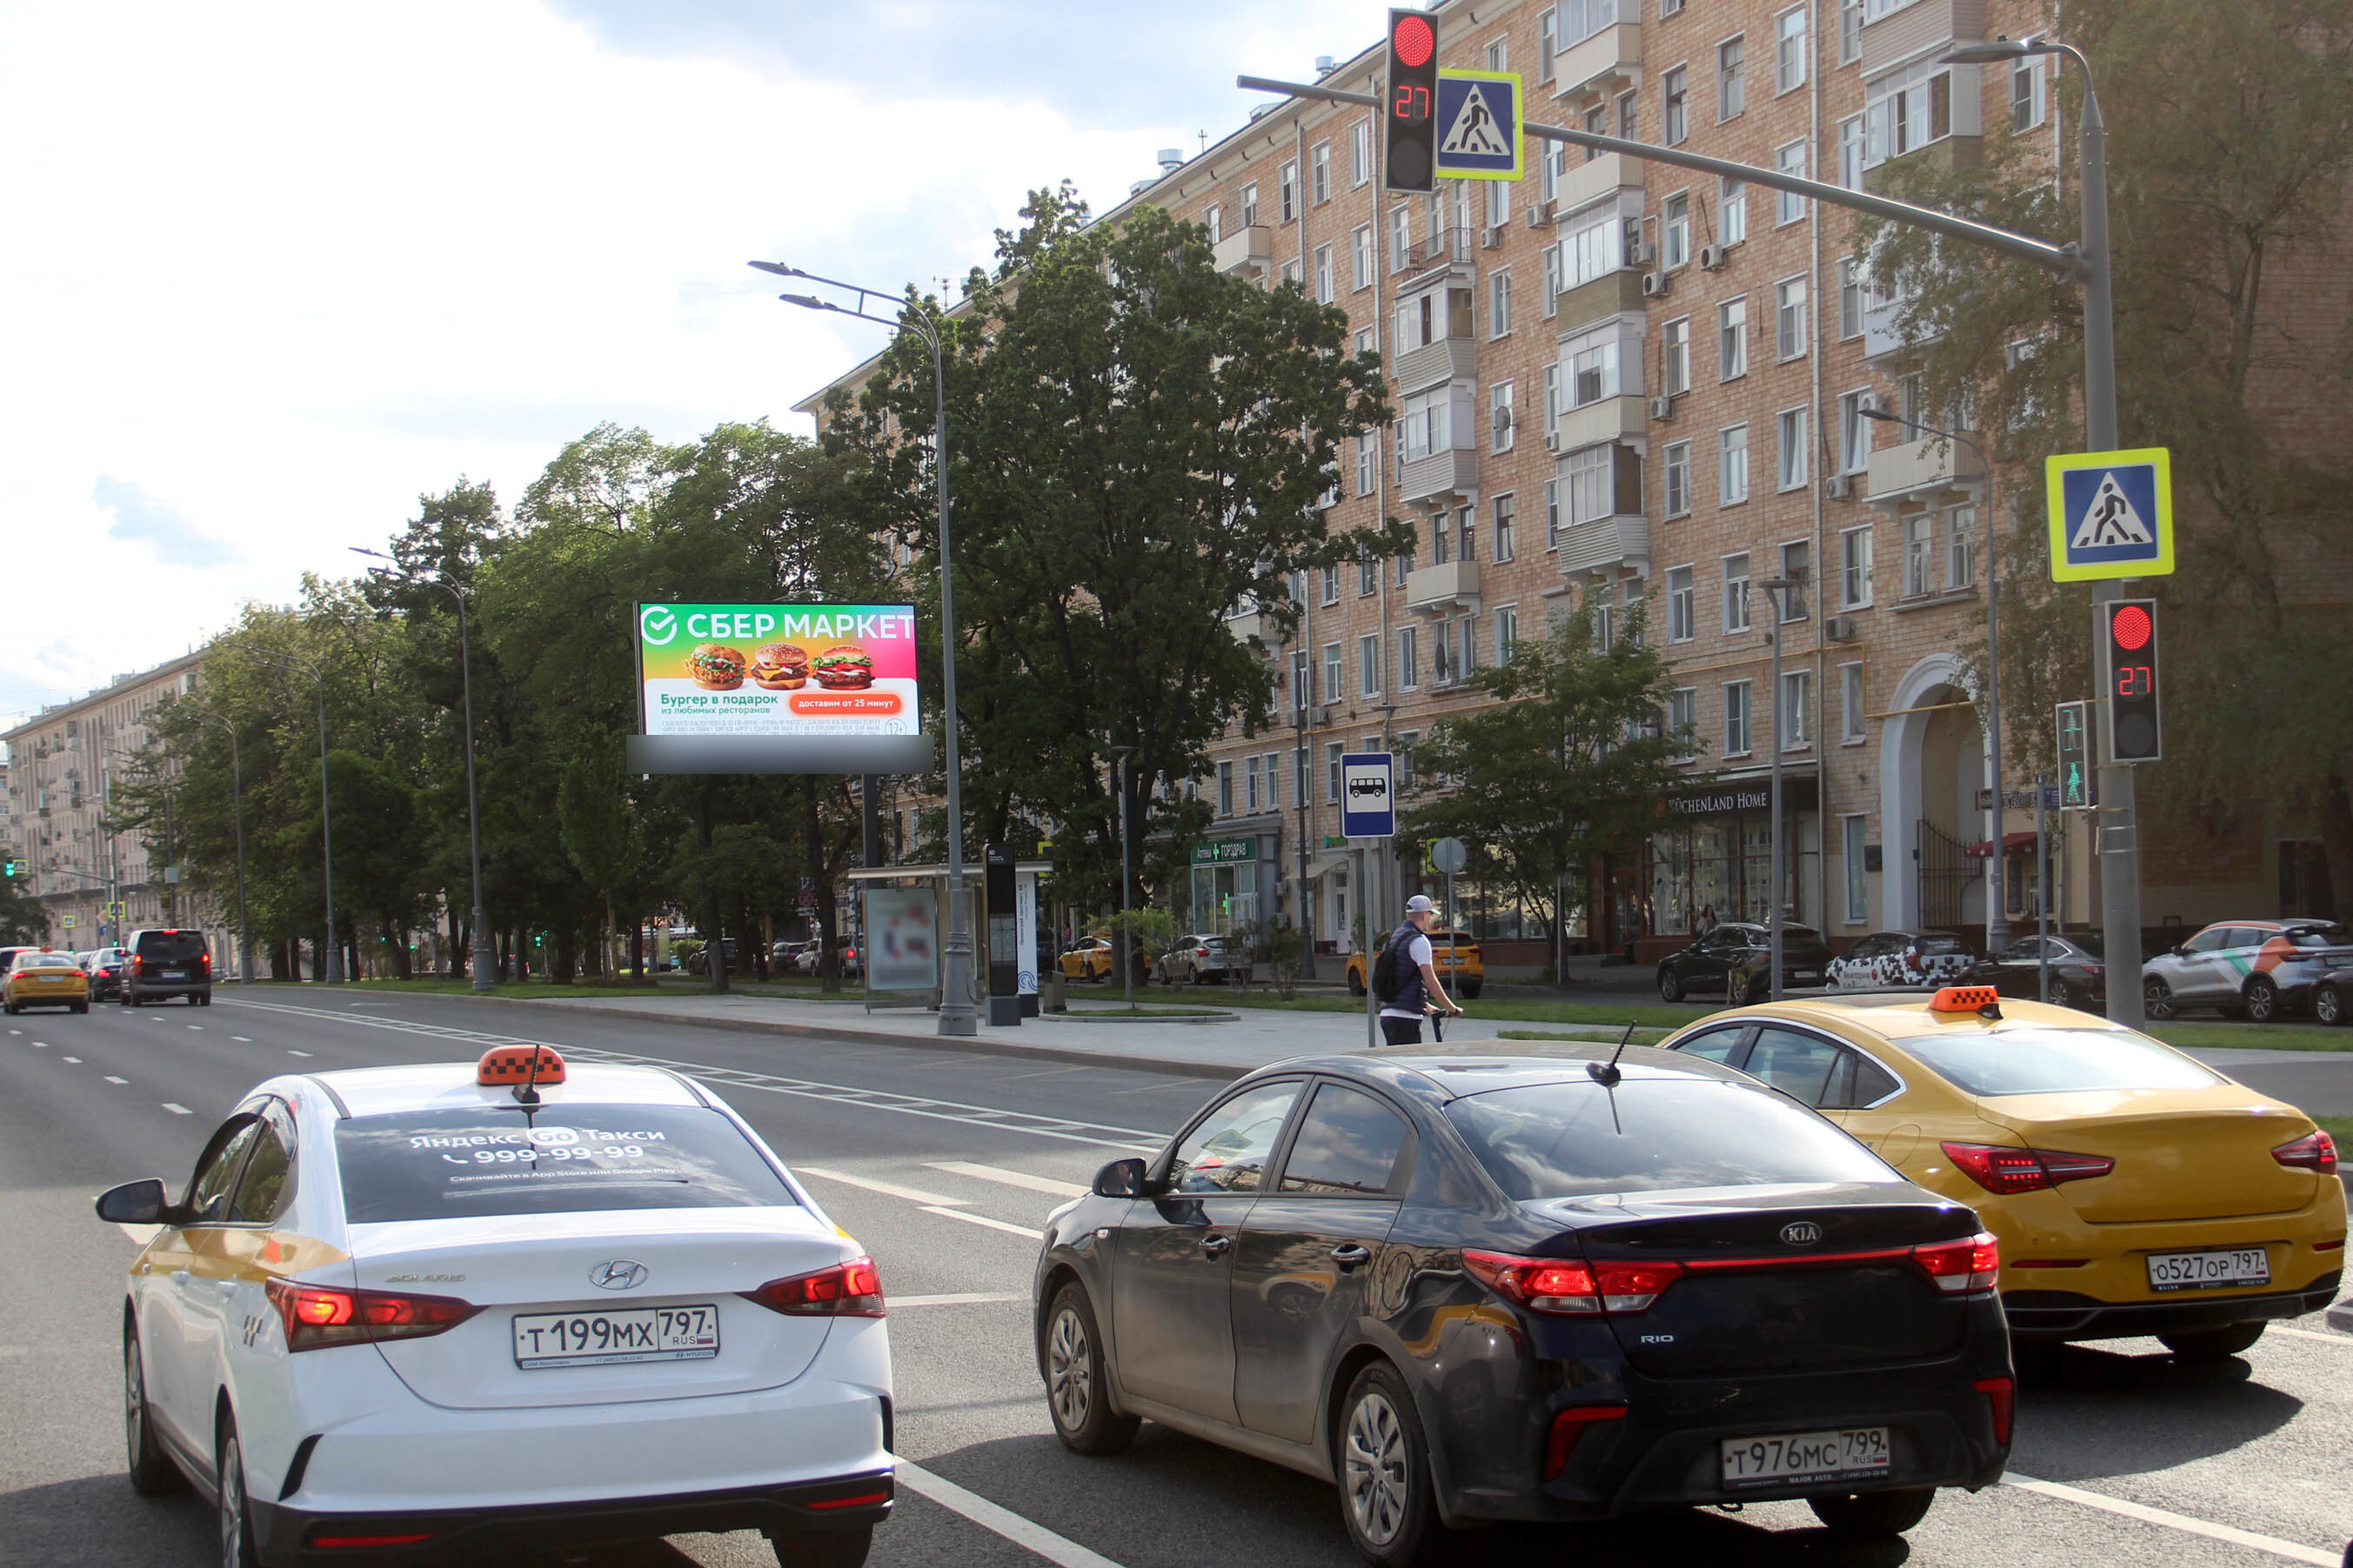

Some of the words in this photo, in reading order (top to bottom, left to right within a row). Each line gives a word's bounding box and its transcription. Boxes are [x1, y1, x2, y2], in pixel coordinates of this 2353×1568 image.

[1396, 85, 1430, 117] 27
[687, 613, 775, 638] СБЕР
[785, 613, 914, 638] МАРКЕТ
[2119, 666, 2151, 695] 27
[660, 694, 708, 707] Бургер
[722, 696, 779, 706] подарок
[799, 699, 840, 708] доставим
[867, 699, 893, 708] минут
[672, 706, 717, 715] любимых
[719, 707, 771, 717] ресторанов
[1737, 792, 1768, 809] HOME
[1220, 843, 1247, 858] ГОРЗДРАВ
[411, 1134, 521, 1148] Яндекс
[582, 1129, 666, 1141] Такси
[474, 1145, 644, 1164] 999-99-99
[450, 1173, 521, 1182] Скачивайте
[1788, 1227, 1816, 1241] KIA
[2232, 1252, 2260, 1270] 797
[658, 1311, 706, 1336] 797
[672, 1336, 696, 1345] RUS
[1641, 1335, 1674, 1344] RIO
[1842, 1431, 1882, 1456] 799
[1853, 1454, 1873, 1465] RUS
